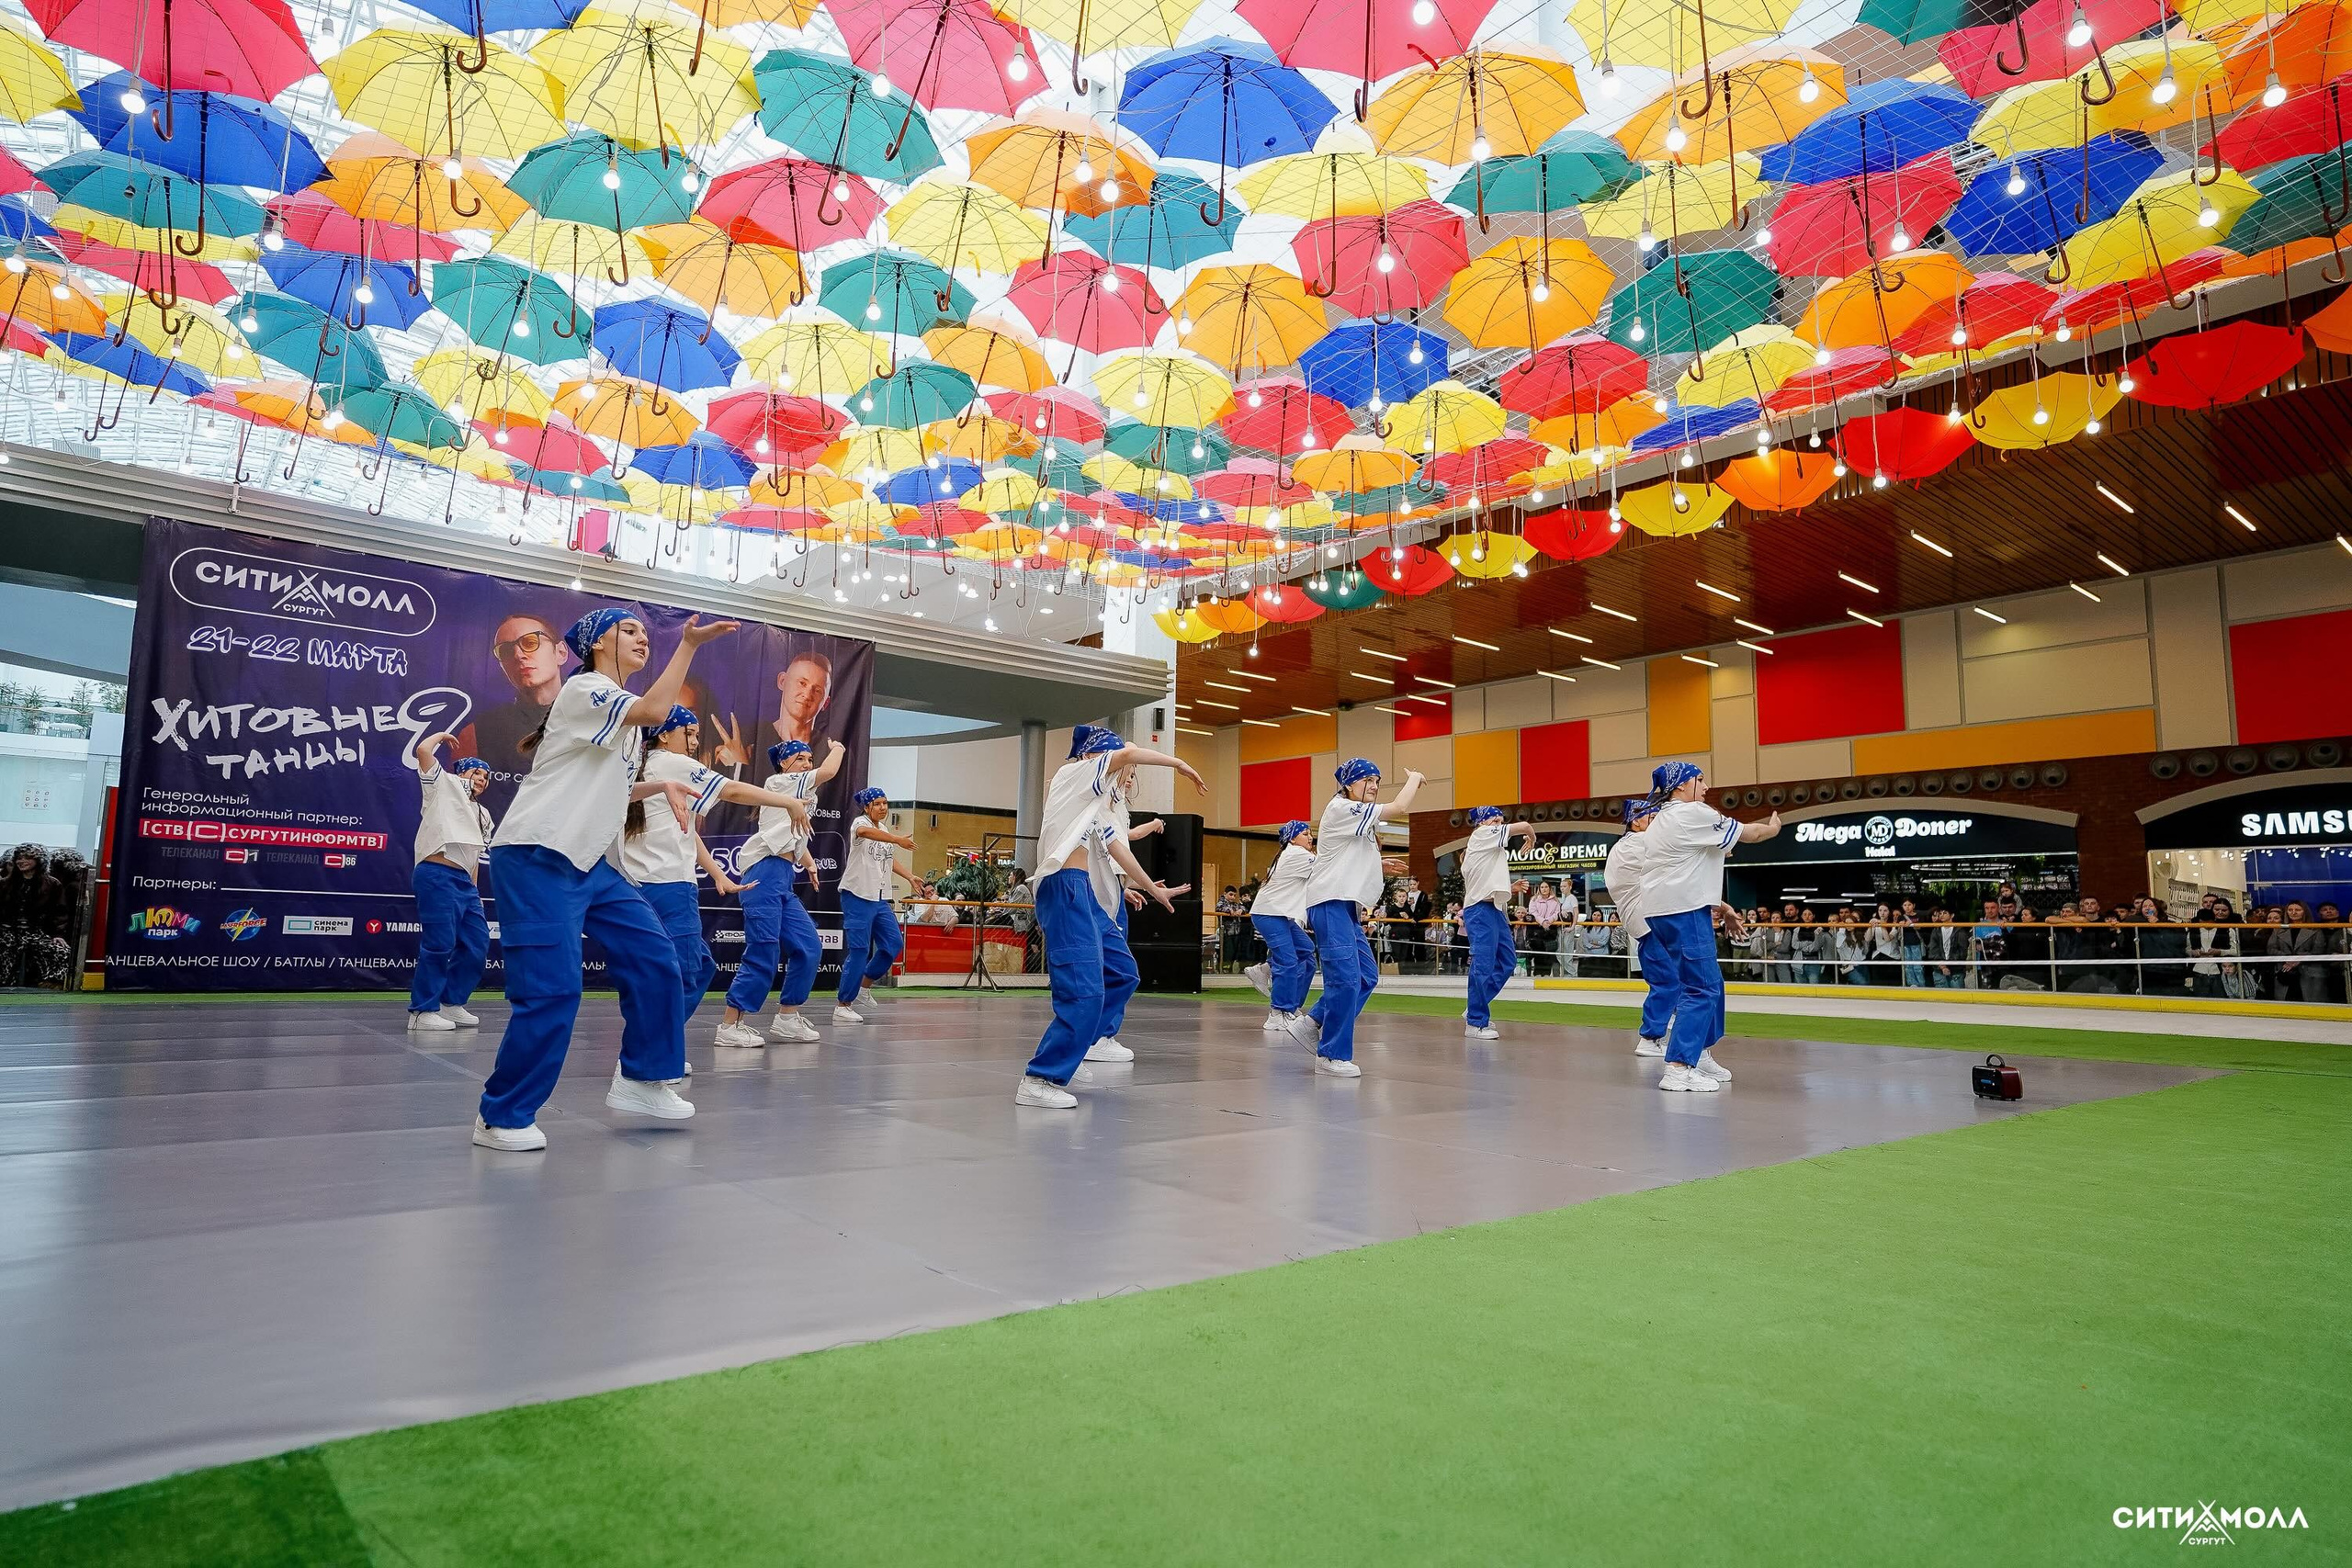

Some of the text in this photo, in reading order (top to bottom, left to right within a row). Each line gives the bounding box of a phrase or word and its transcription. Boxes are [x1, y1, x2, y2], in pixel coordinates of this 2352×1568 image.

[196, 561, 415, 615] СИТИ МОЛЛ
[283, 604, 325, 617] СУРГУТ
[187, 626, 408, 676] 21-22 МАРТА
[206, 736, 365, 780] ТАНЦЫ
[143, 787, 250, 805] Генеральный
[141, 801, 363, 827] информационный партнер:
[1795, 822, 1862, 845] Mega
[1894, 818, 1973, 838] Doner
[161, 847, 220, 860] ТЕЛЕКАНАЛ
[266, 852, 319, 865] ТЕЛЕКАНАЛ
[1560, 844, 1607, 859] ВРЕМЯ
[1865, 845, 1896, 857] Halal
[132, 875, 217, 892] Партнеры:
[148, 928, 178, 939] парк
[223, 956, 260, 967] ШОУ
[275, 956, 325, 968] БАТТЛЫ
